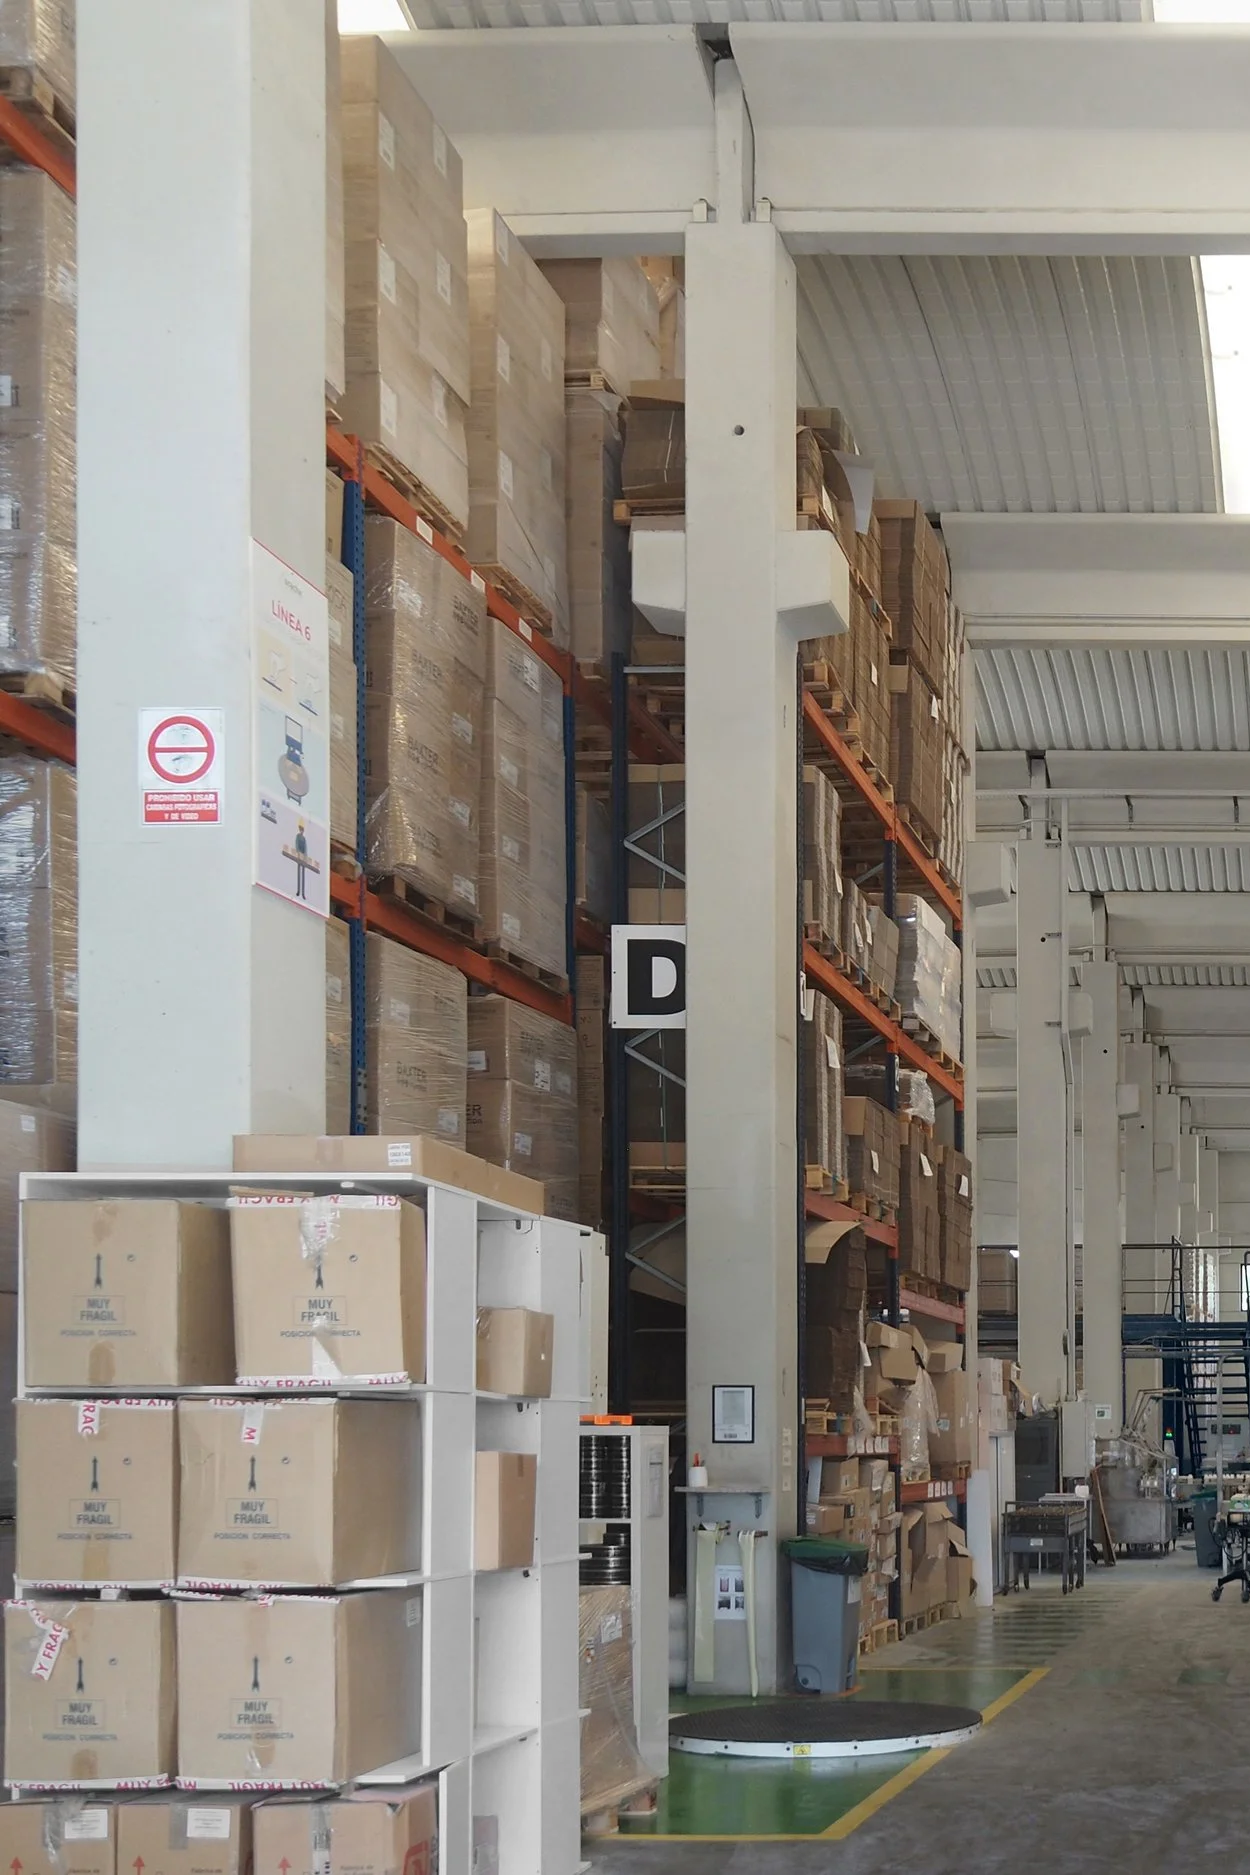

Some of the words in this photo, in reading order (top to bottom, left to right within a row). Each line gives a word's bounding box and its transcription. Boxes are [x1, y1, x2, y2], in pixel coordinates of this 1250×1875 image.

[304, 626, 312, 642] 6
[193, 793, 216, 802] USAR
[627, 938, 687, 1016] D
[87, 1299, 110, 1309] MUY
[308, 1299, 333, 1310] MUY
[80, 1310, 117, 1321] FRAGIL
[83, 1502, 107, 1512] MUY
[240, 1501, 265, 1512] MUY
[76, 1514, 113, 1525] FRAGIL
[233, 1514, 271, 1525] FRAGIL
[69, 1703, 92, 1713] MUY
[244, 1702, 268, 1712] MUY
[62, 1715, 98, 1726] FRAGIL
[237, 1714, 274, 1725] FRAGIL
